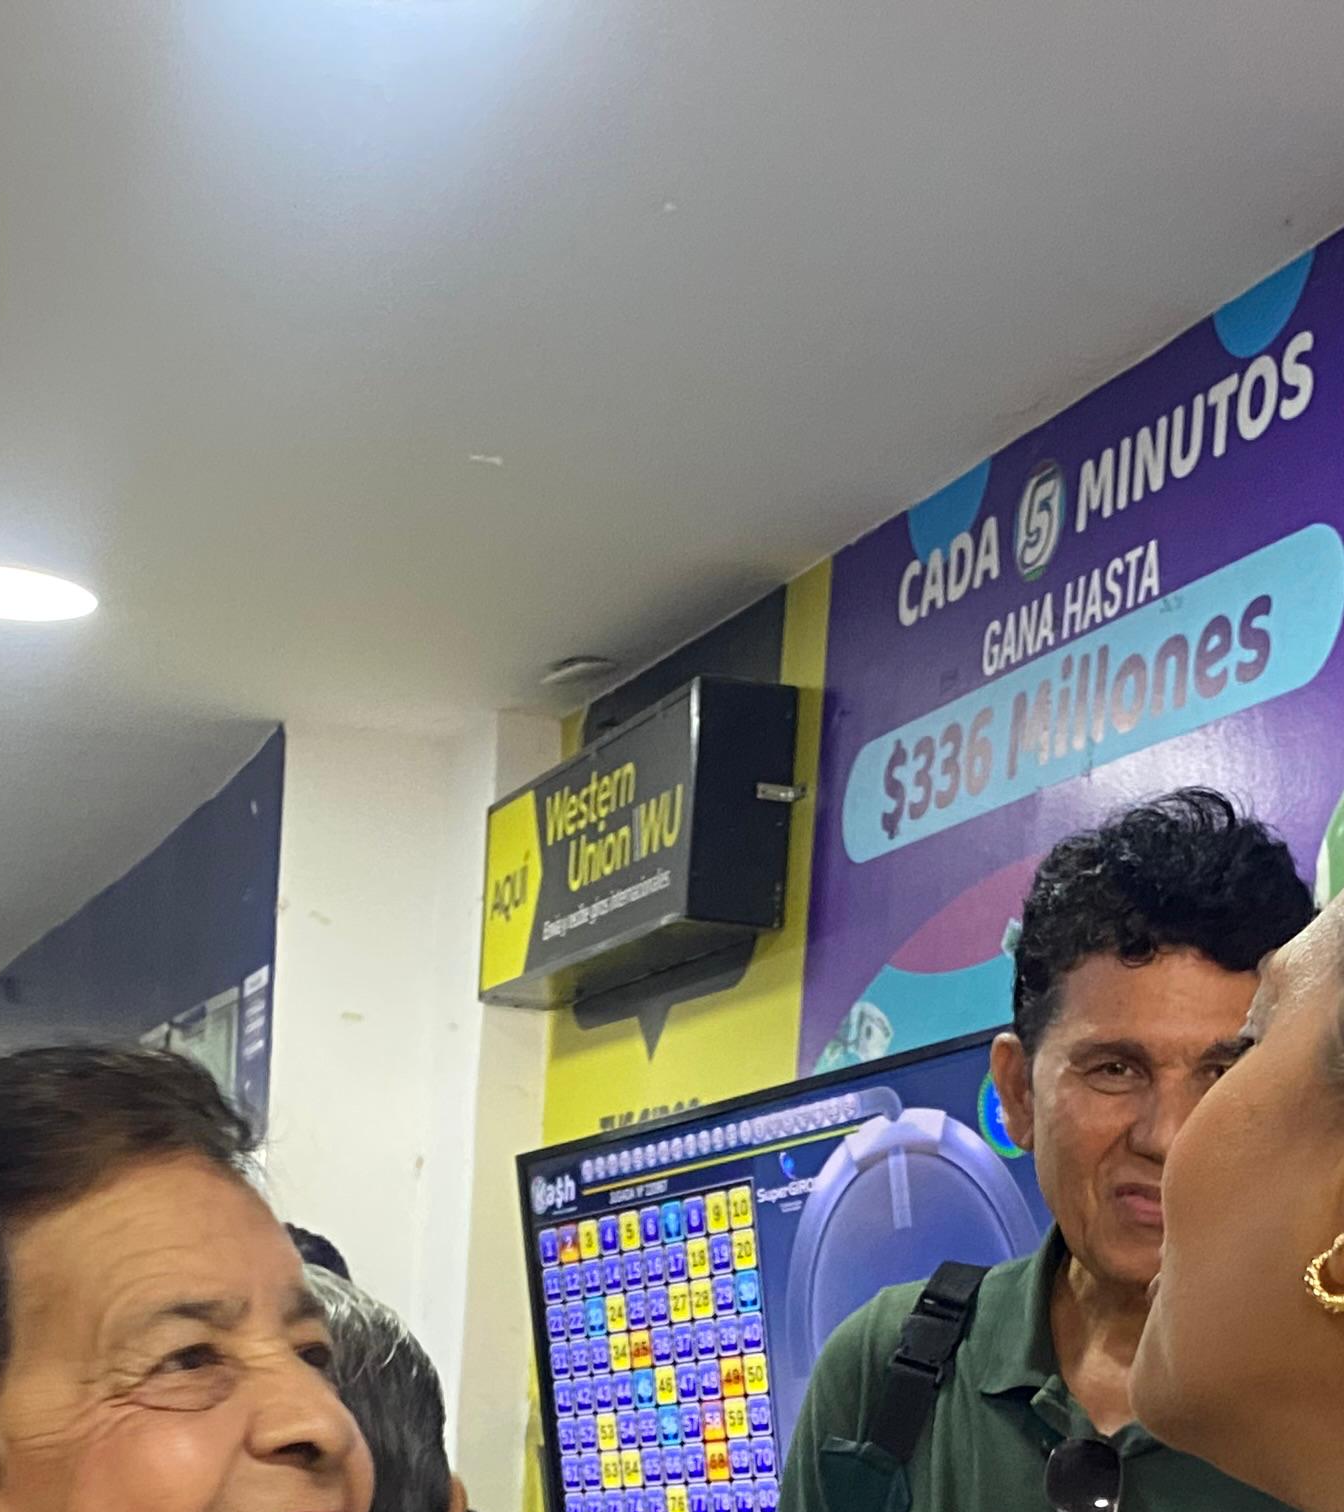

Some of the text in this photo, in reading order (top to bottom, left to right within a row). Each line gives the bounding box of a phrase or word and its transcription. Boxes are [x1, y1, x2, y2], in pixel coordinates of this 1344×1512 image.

[898, 331, 1315, 627] CADA 5 MINUTOS
[983, 540, 1161, 676] GANA HASTA
[881, 593, 1273, 840] $336 Millones
[545, 761, 636, 847] Western
[568, 820, 631, 892] Union
